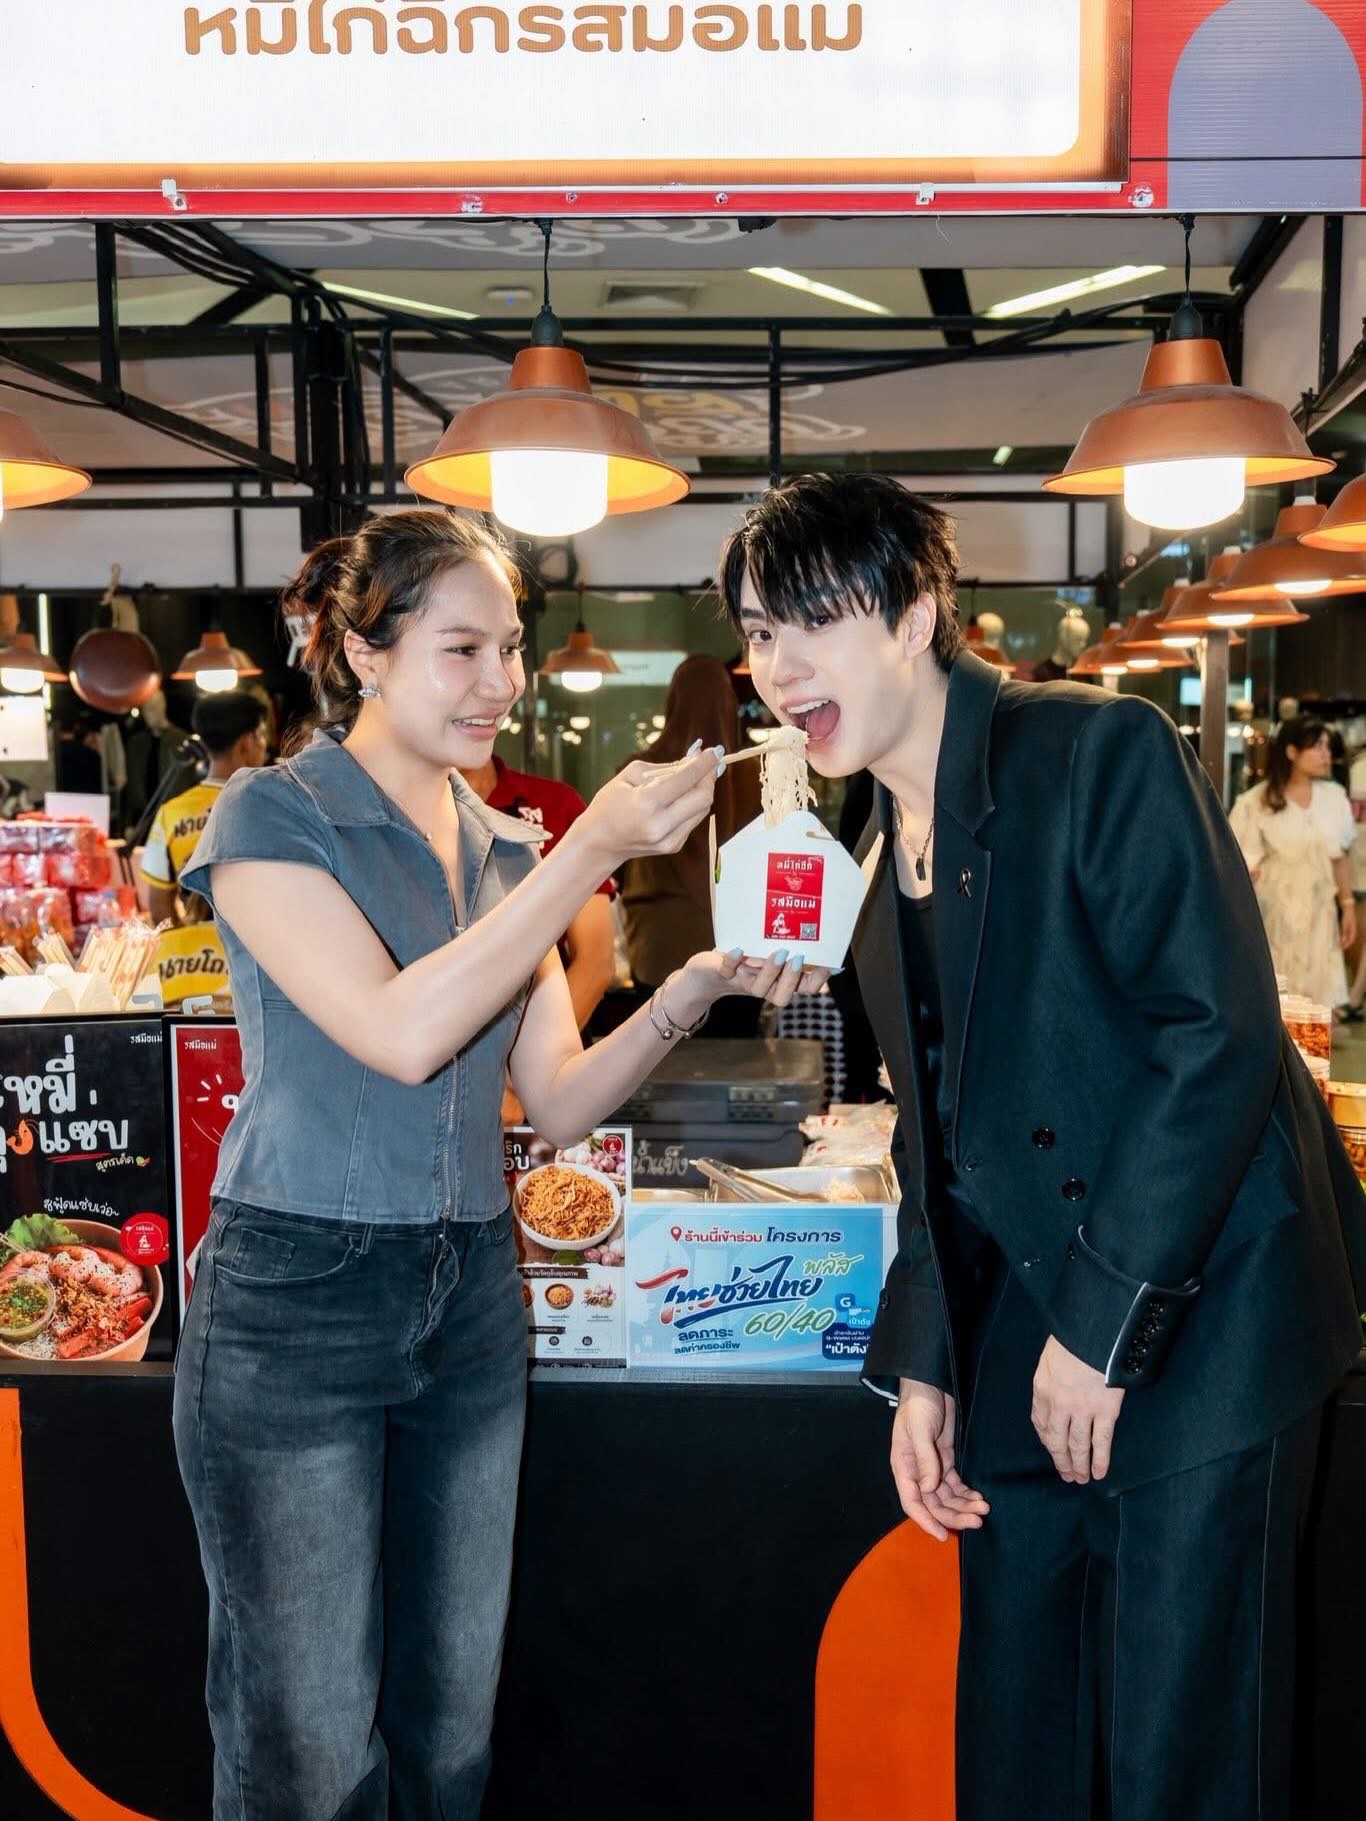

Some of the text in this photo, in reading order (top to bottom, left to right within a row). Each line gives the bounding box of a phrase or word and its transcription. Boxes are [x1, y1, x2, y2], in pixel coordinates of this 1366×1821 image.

[685, 1226, 842, 1243] ร้านนี้เข้าร่วม โครงการ
[636, 1252, 864, 1325] ไทยช่วยไทย พลัส
[840, 1297, 851, 1307] G
[745, 1303, 836, 1340] 60/40
[678, 1328, 734, 1342] ลดภาระ
[674, 1341, 741, 1355] ลดค่าครองชีพ
